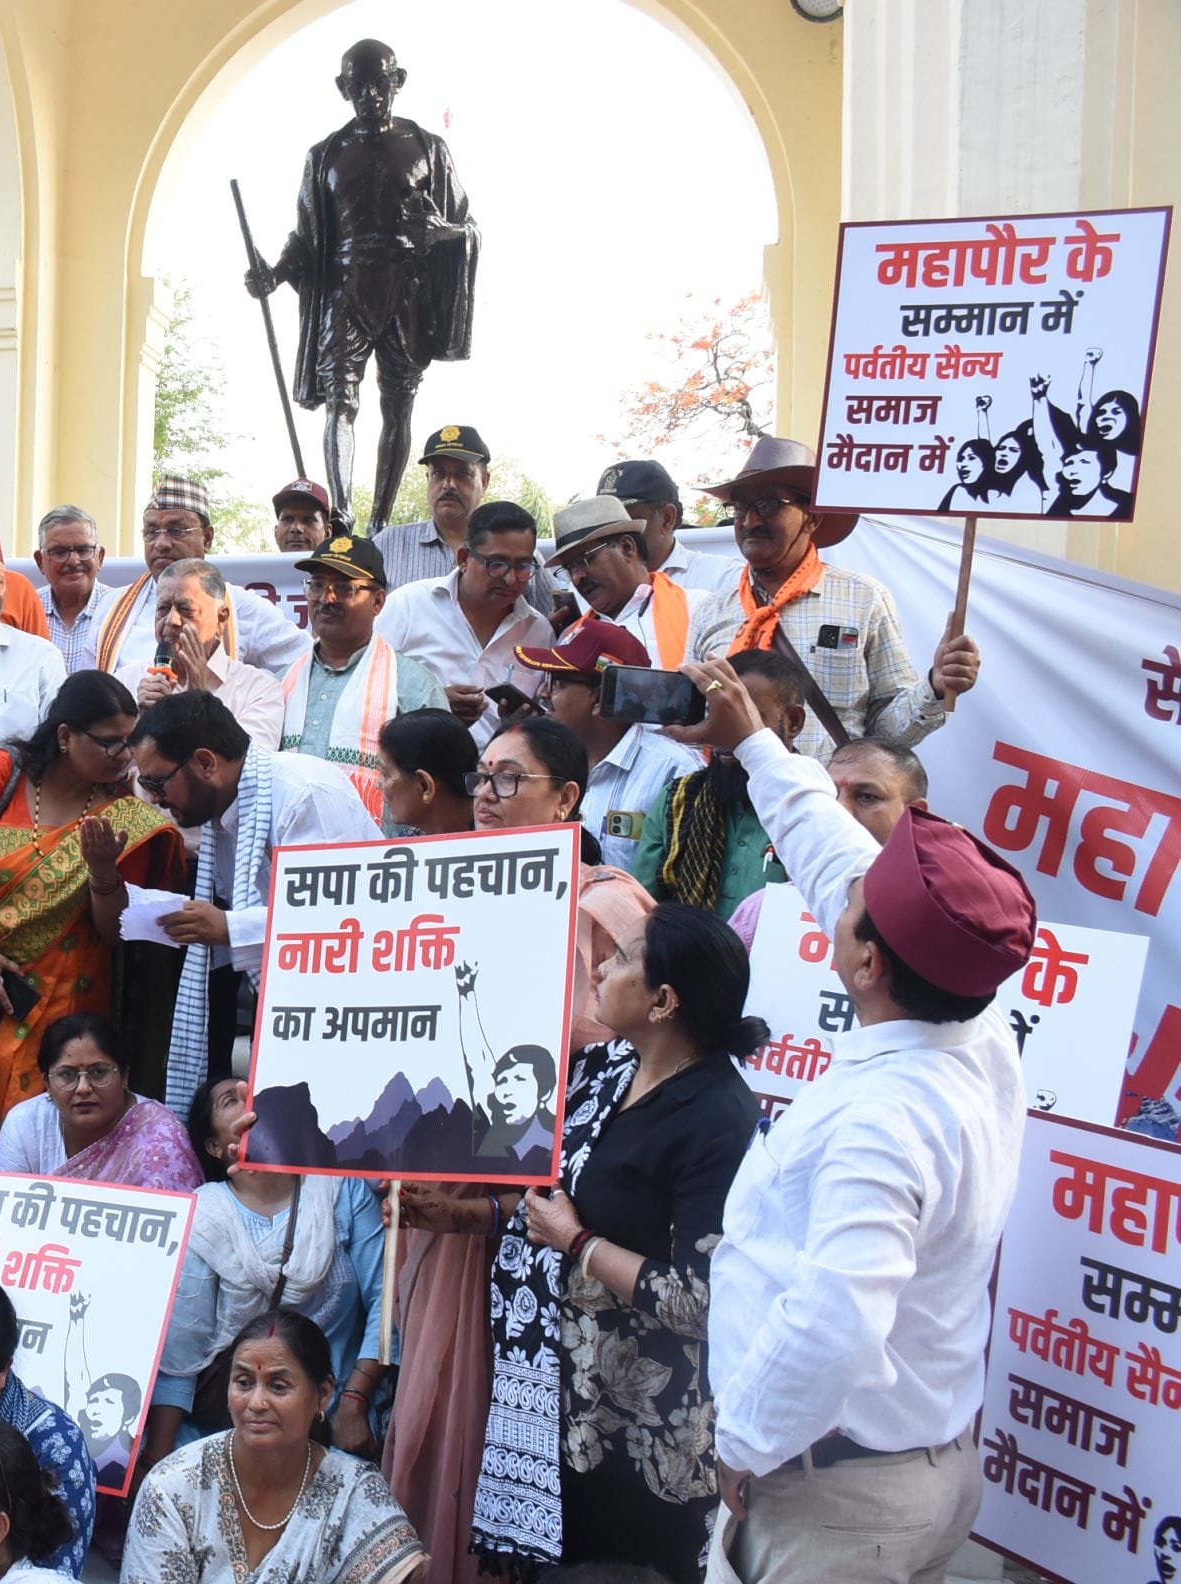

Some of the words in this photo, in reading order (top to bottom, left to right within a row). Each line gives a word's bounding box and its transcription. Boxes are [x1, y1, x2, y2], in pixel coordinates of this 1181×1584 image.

[875, 223, 1056, 288] महापौर
[1064, 219, 1121, 282] के
[900, 301, 1034, 337] सम्मान
[1040, 290, 1085, 335] में
[843, 344, 931, 380] पर्वतीय
[935, 344, 1004, 380] सैन्य
[845, 395, 942, 425] समाज
[826, 433, 913, 473] मैदान
[919, 434, 955, 474] में
[284, 864, 361, 907] सपा
[366, 847, 419, 904] की
[424, 847, 568, 901] पहचान,
[276, 917, 364, 974] नारी
[371, 914, 461, 972] शक्ति
[271, 1006, 316, 1042] का
[321, 1004, 442, 1042] अपमान
[11, 1182, 56, 1230] की
[59, 1196, 179, 1256] पहचान,
[1, 1243, 82, 1294] शक्ति
[1008, 1306, 1120, 1388] पर्वतीय
[1008, 1372, 1135, 1468] समाज
[983, 1428, 1095, 1530] मैदान
[1101, 1485, 1152, 1555] में
